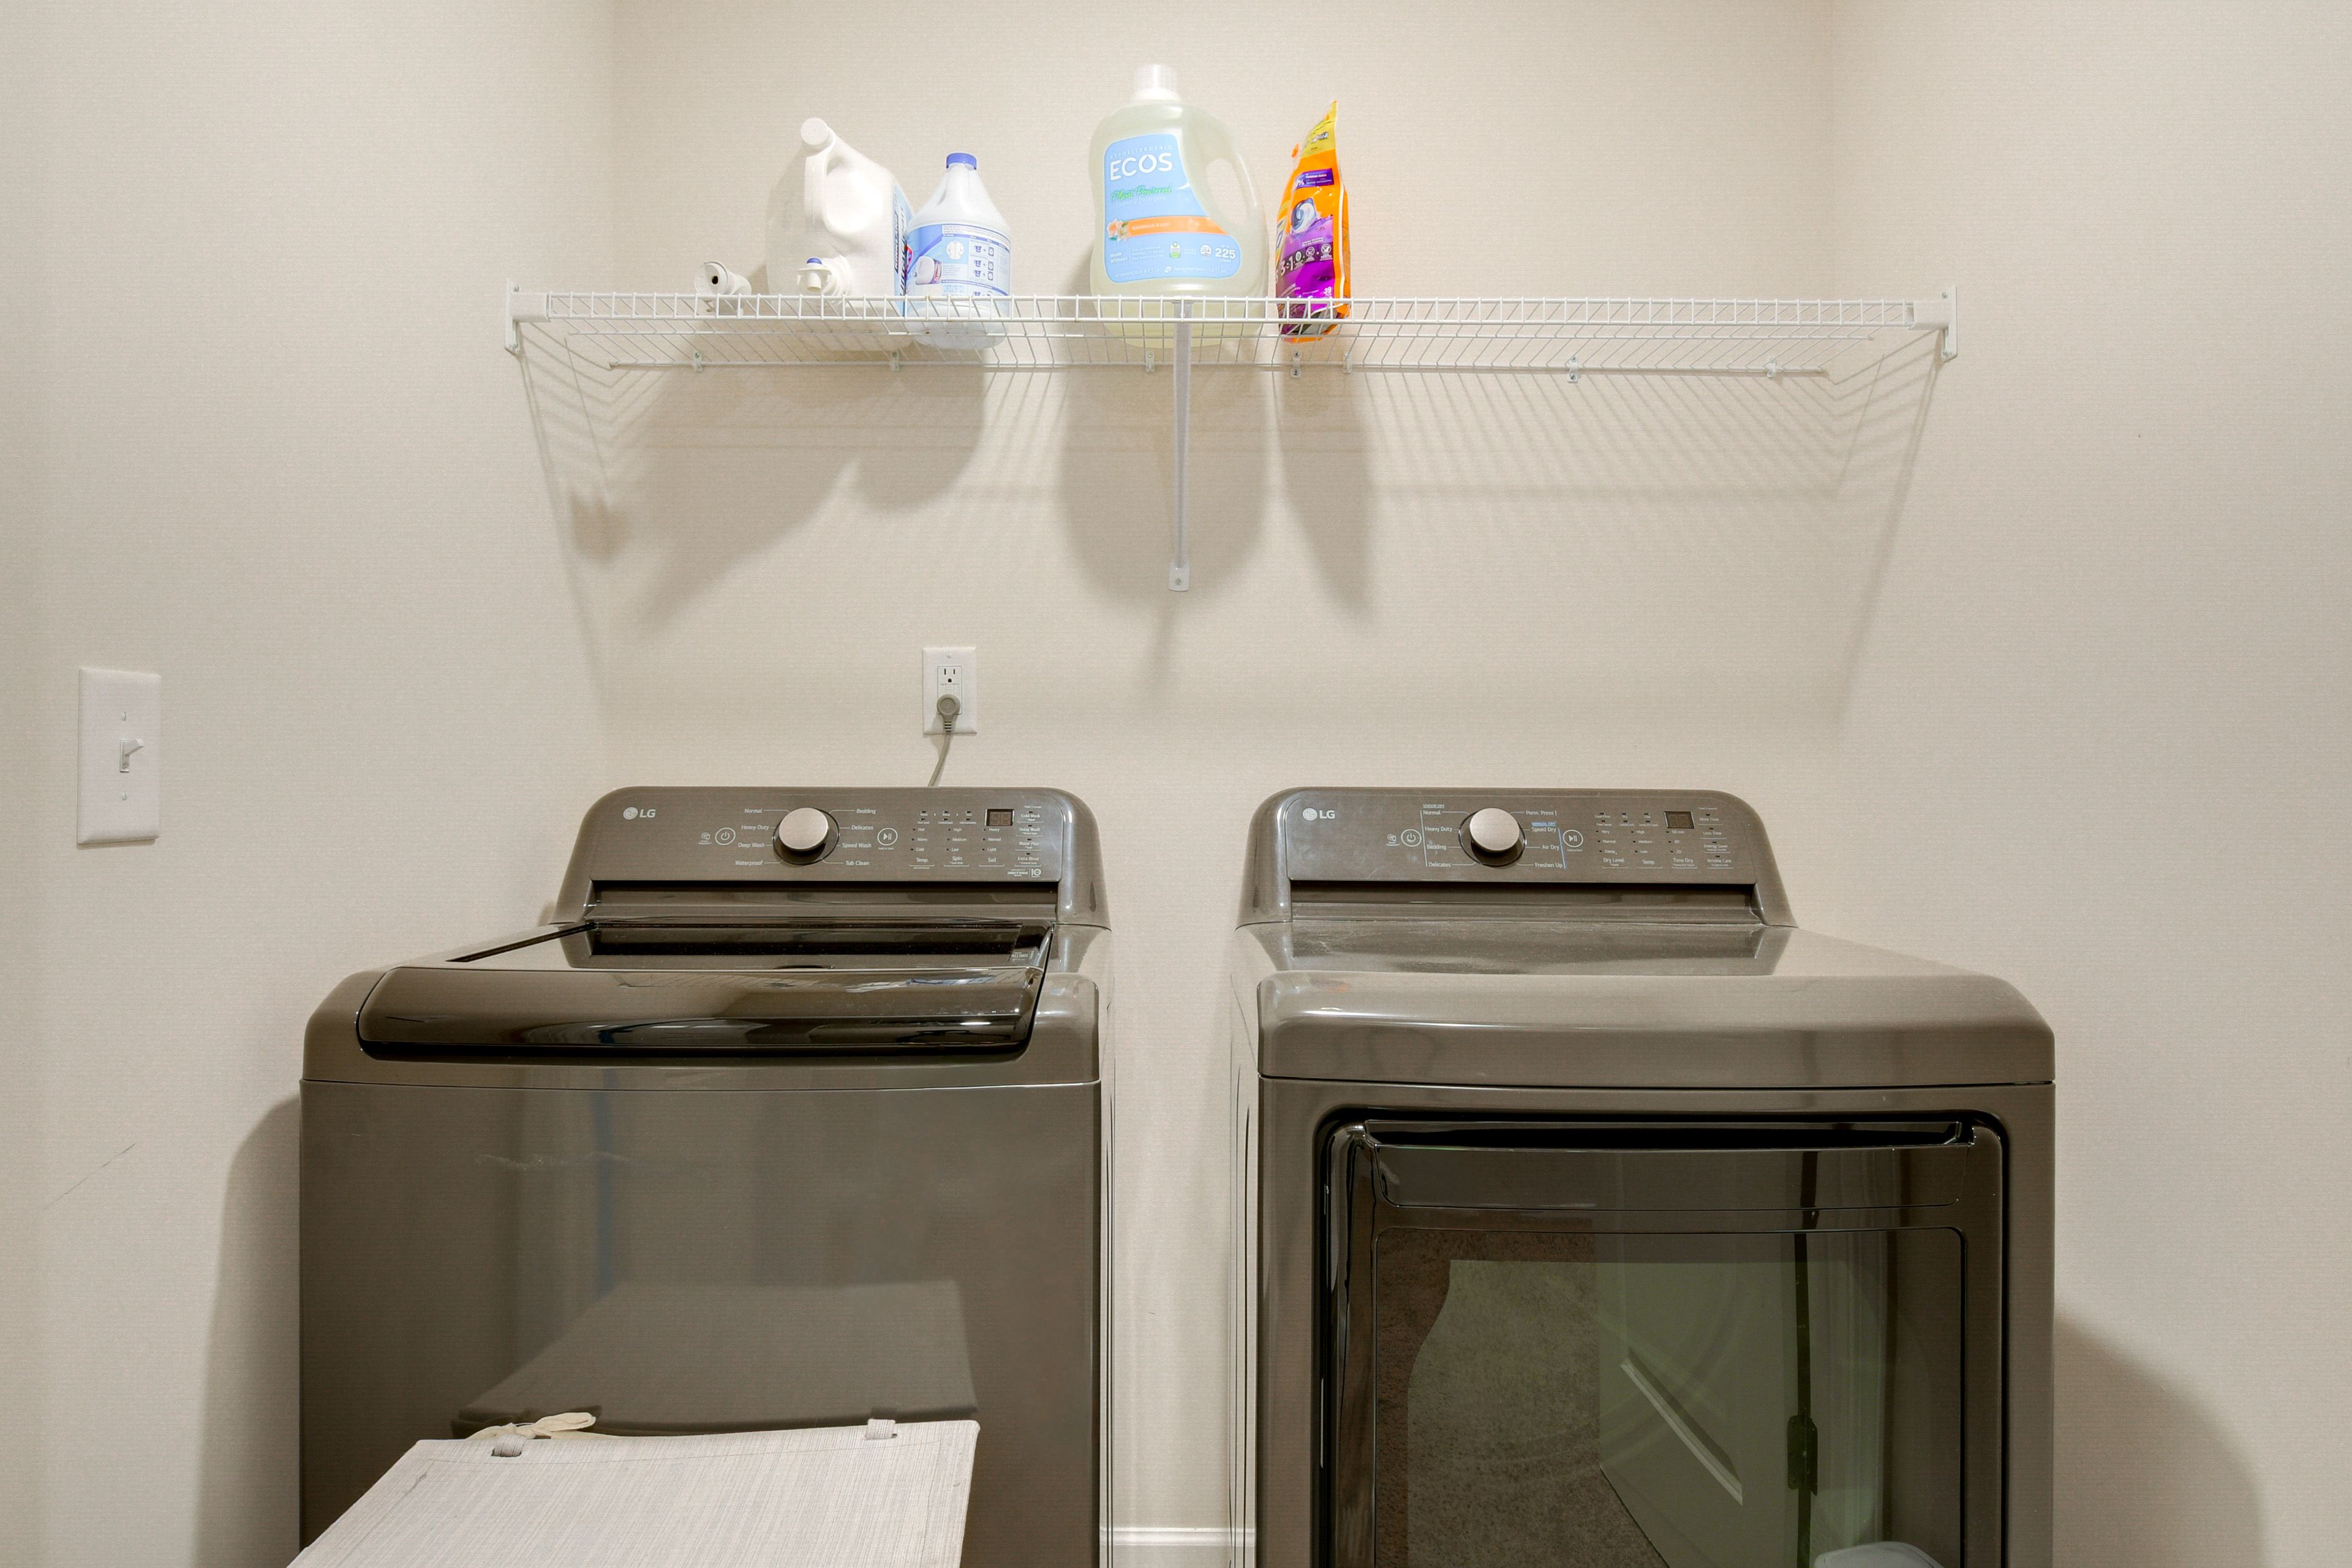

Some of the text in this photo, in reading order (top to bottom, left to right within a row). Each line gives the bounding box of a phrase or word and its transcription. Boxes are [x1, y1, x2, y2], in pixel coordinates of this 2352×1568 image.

[1110, 152, 1173, 181] ECOS
[1110, 183, 1172, 203] Plant Powered
[1215, 247, 1236, 259] 225
[639, 809, 656, 818] LG
[1319, 810, 1335, 819] LG
